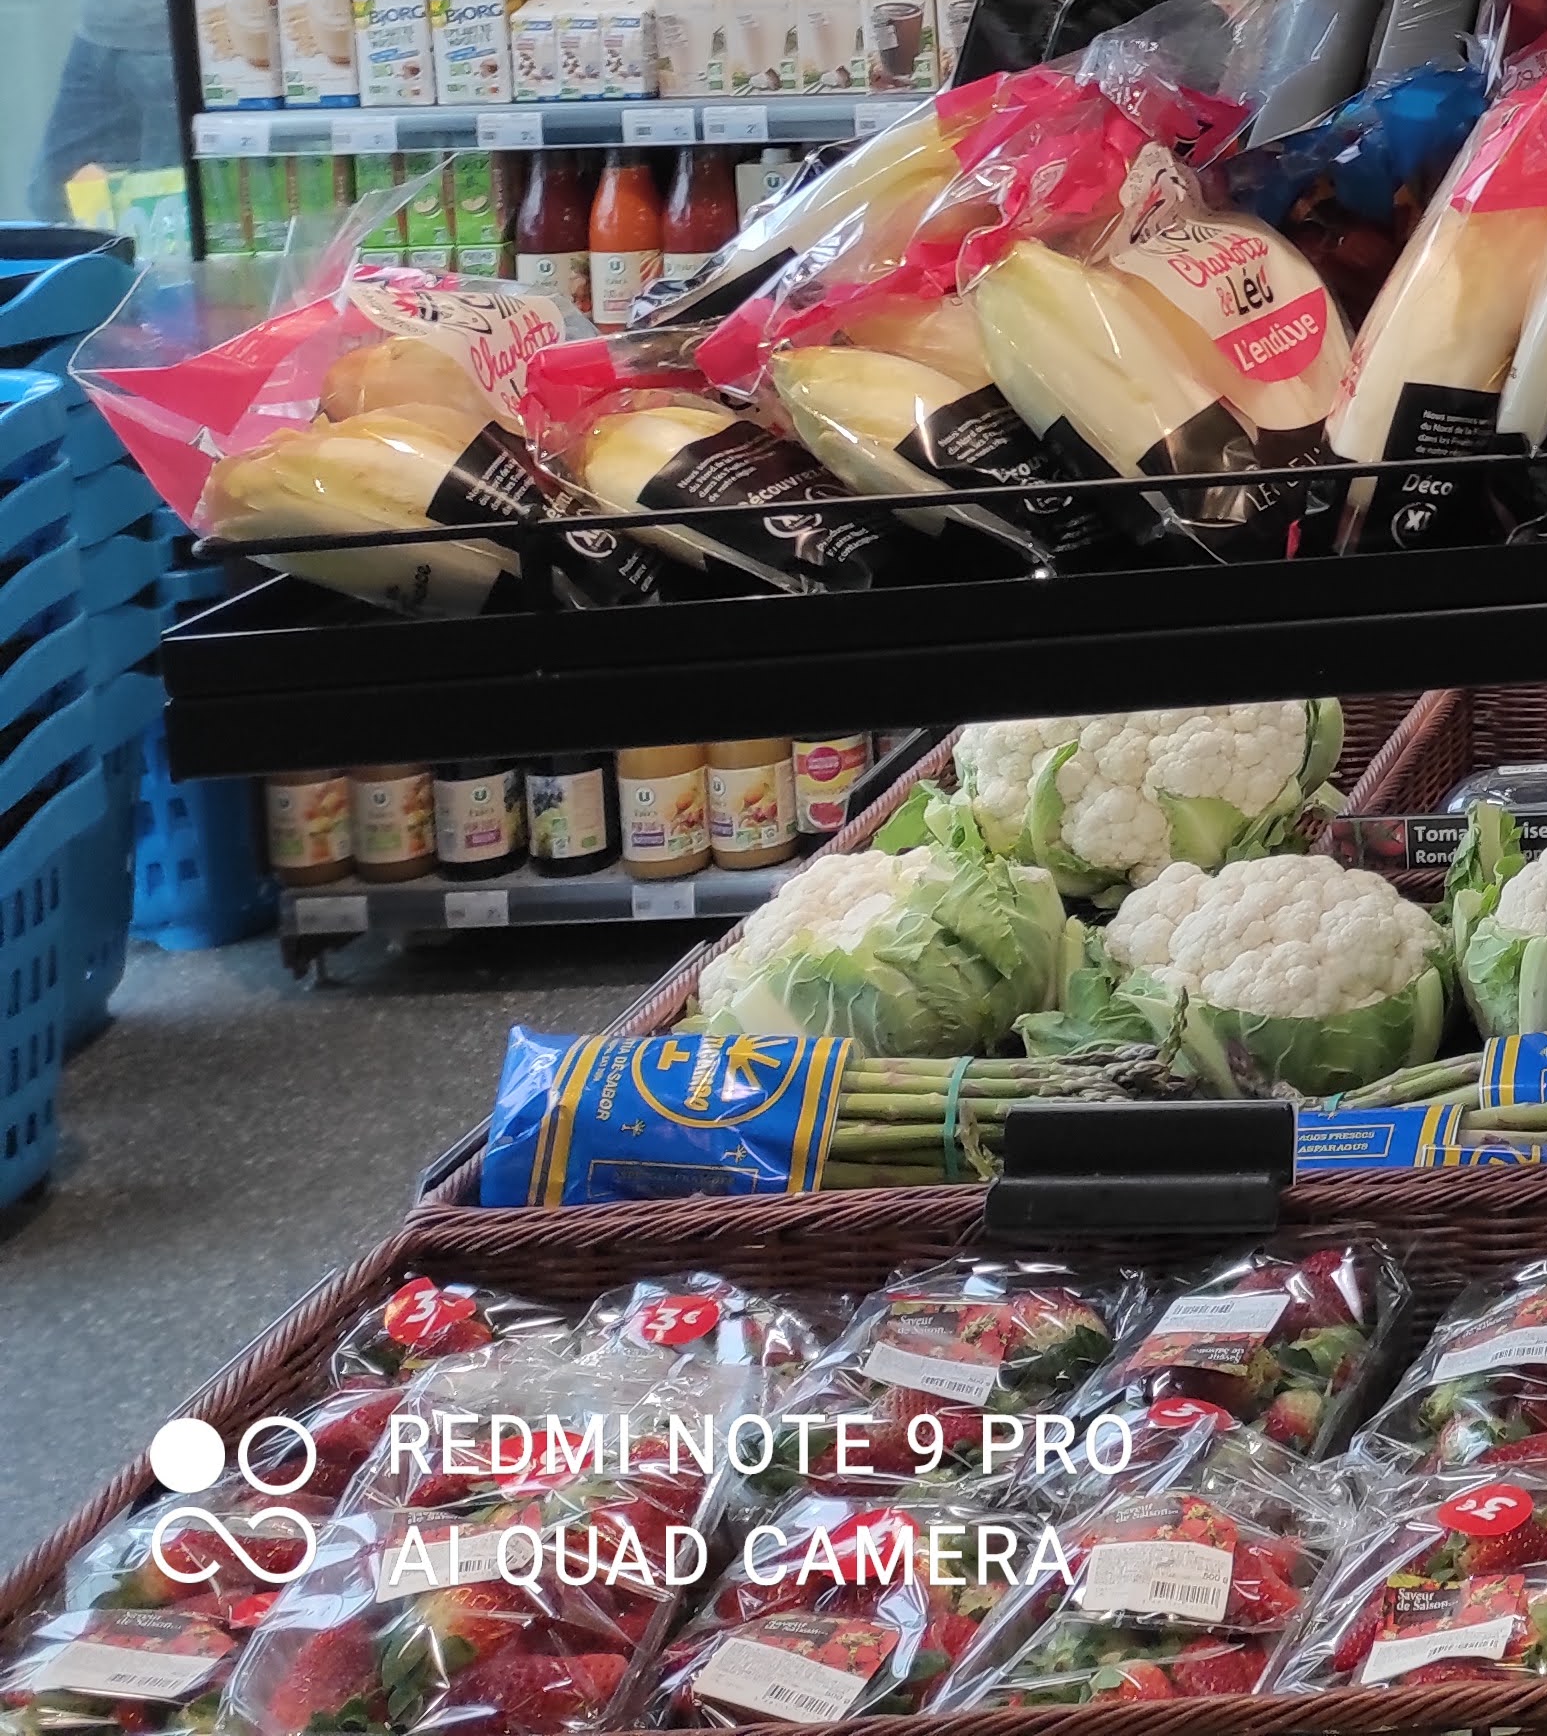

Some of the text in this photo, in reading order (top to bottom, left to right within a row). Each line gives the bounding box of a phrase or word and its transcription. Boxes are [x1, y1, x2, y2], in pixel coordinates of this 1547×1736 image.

[1168, 233, 1269, 289] Charlotte
[470, 310, 559, 392] Charlotte
[1233, 312, 1320, 372] L'endive
[1396, 1601, 1411, 1612] de
[1397, 1588, 1435, 1602] Saveur
